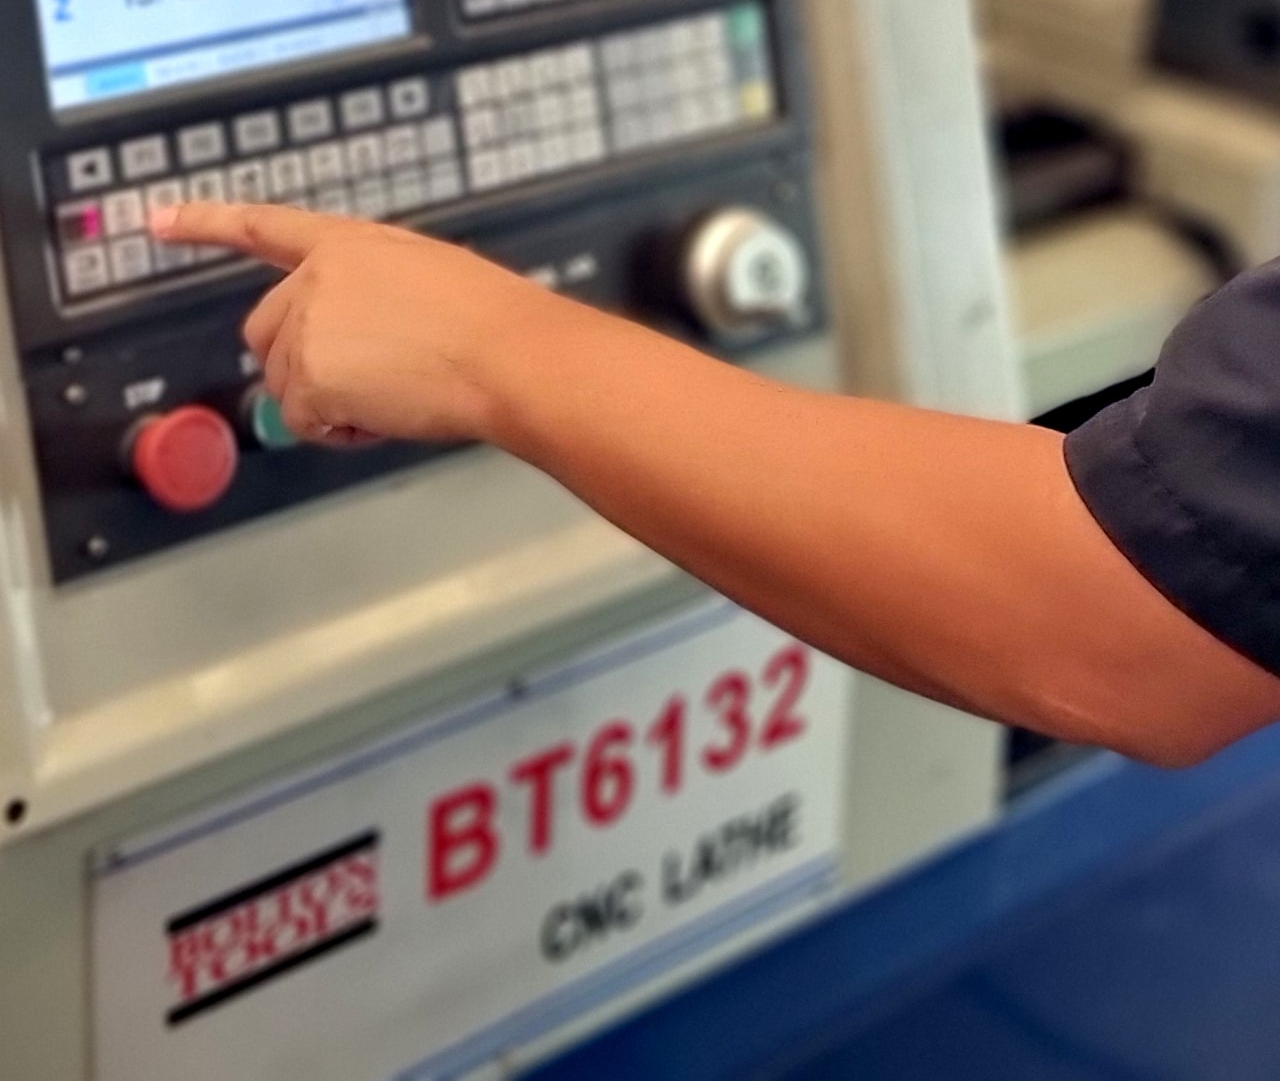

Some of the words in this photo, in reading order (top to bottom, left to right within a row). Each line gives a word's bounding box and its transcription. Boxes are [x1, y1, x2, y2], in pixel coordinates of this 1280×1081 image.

[426, 643, 811, 906] BT6132
[539, 868, 647, 964] CNC
[660, 790, 803, 906] LATHE
